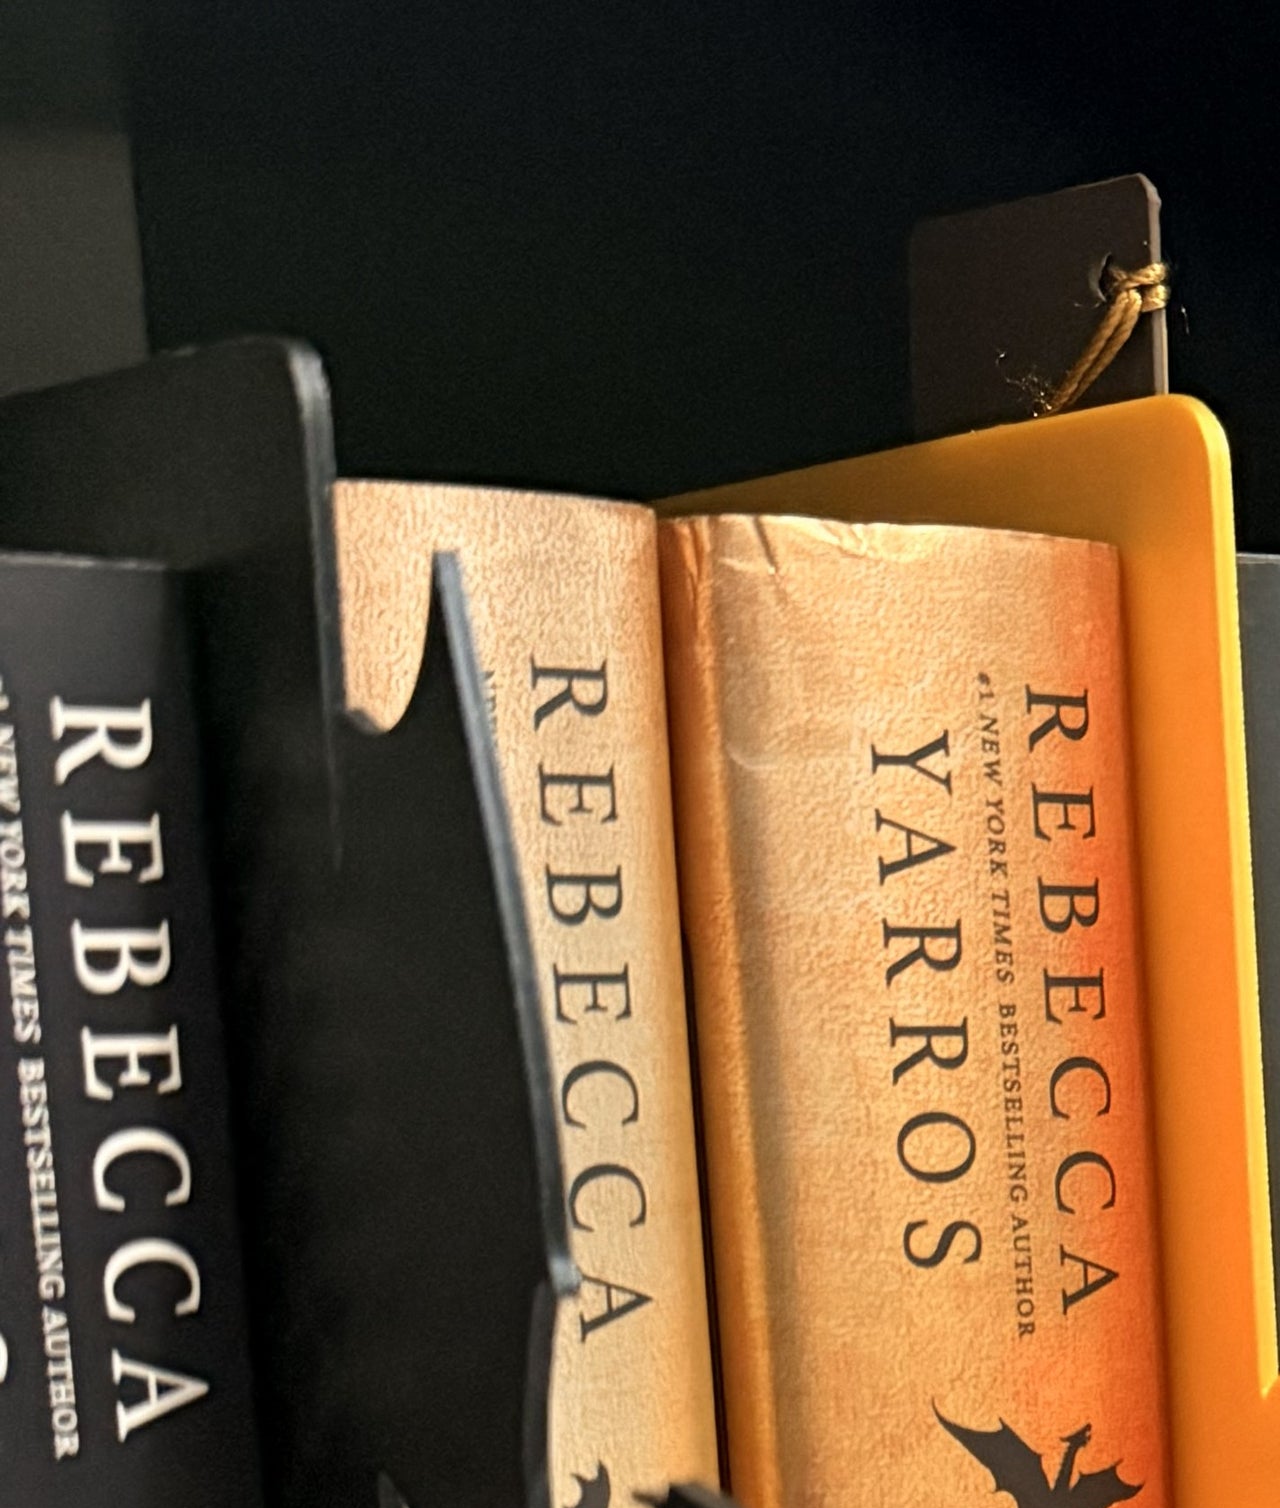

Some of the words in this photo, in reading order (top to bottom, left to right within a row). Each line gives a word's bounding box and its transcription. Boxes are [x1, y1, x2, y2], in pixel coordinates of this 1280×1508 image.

[979, 715, 1001, 783] NEW
[987, 797, 1008, 877] YORK
[4, 924, 41, 1044] TIMES
[529, 655, 654, 1343] REBECCA
[871, 729, 983, 1272] YARROS
[993, 890, 1016, 984] TIMES
[1025, 684, 1120, 1314] REBECCA
[50, 695, 209, 1443] REBECCA
[1001, 1003, 1028, 1202] BESTSELLING
[17, 1056, 66, 1300] BESTSELLING
[1012, 1211, 1036, 1340] AUTHOR
[42, 1304, 80, 1462] AUTHOR
